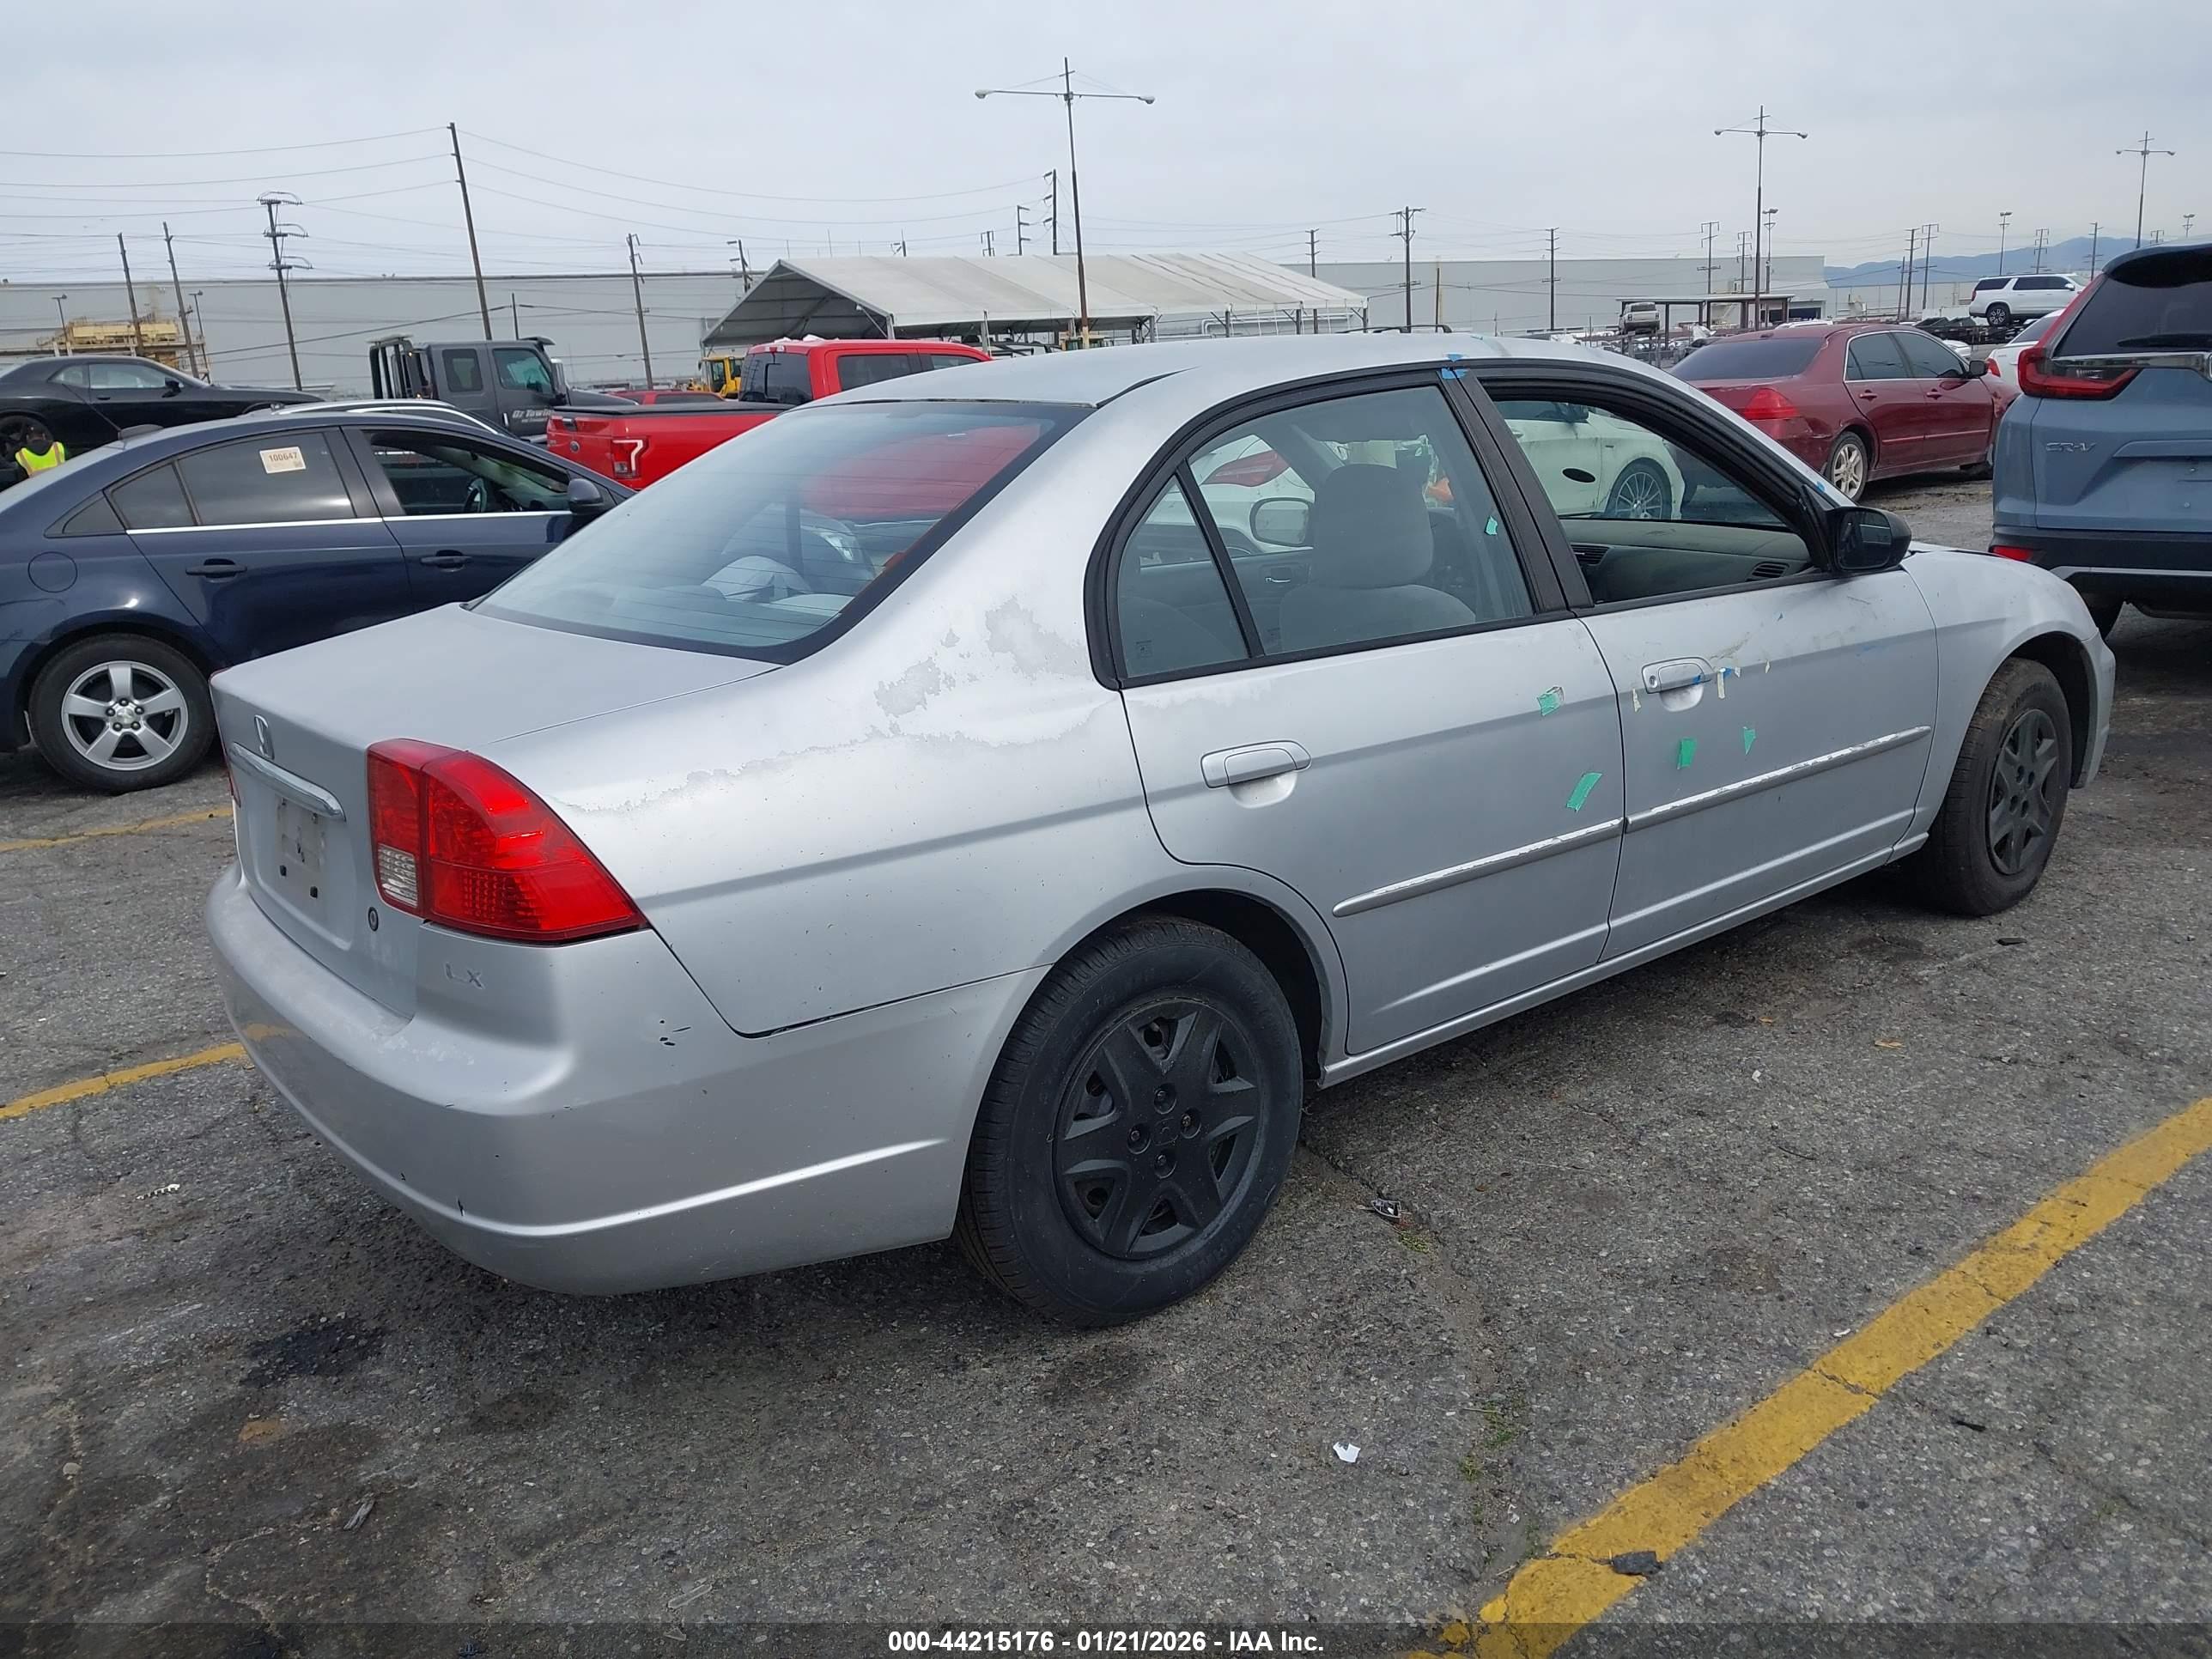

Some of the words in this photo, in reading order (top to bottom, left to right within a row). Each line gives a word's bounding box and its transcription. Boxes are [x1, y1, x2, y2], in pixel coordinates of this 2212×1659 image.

[2045, 441, 2096, 453] CR-V
[269, 452, 298, 462] 100647
[444, 962, 486, 989] LX
